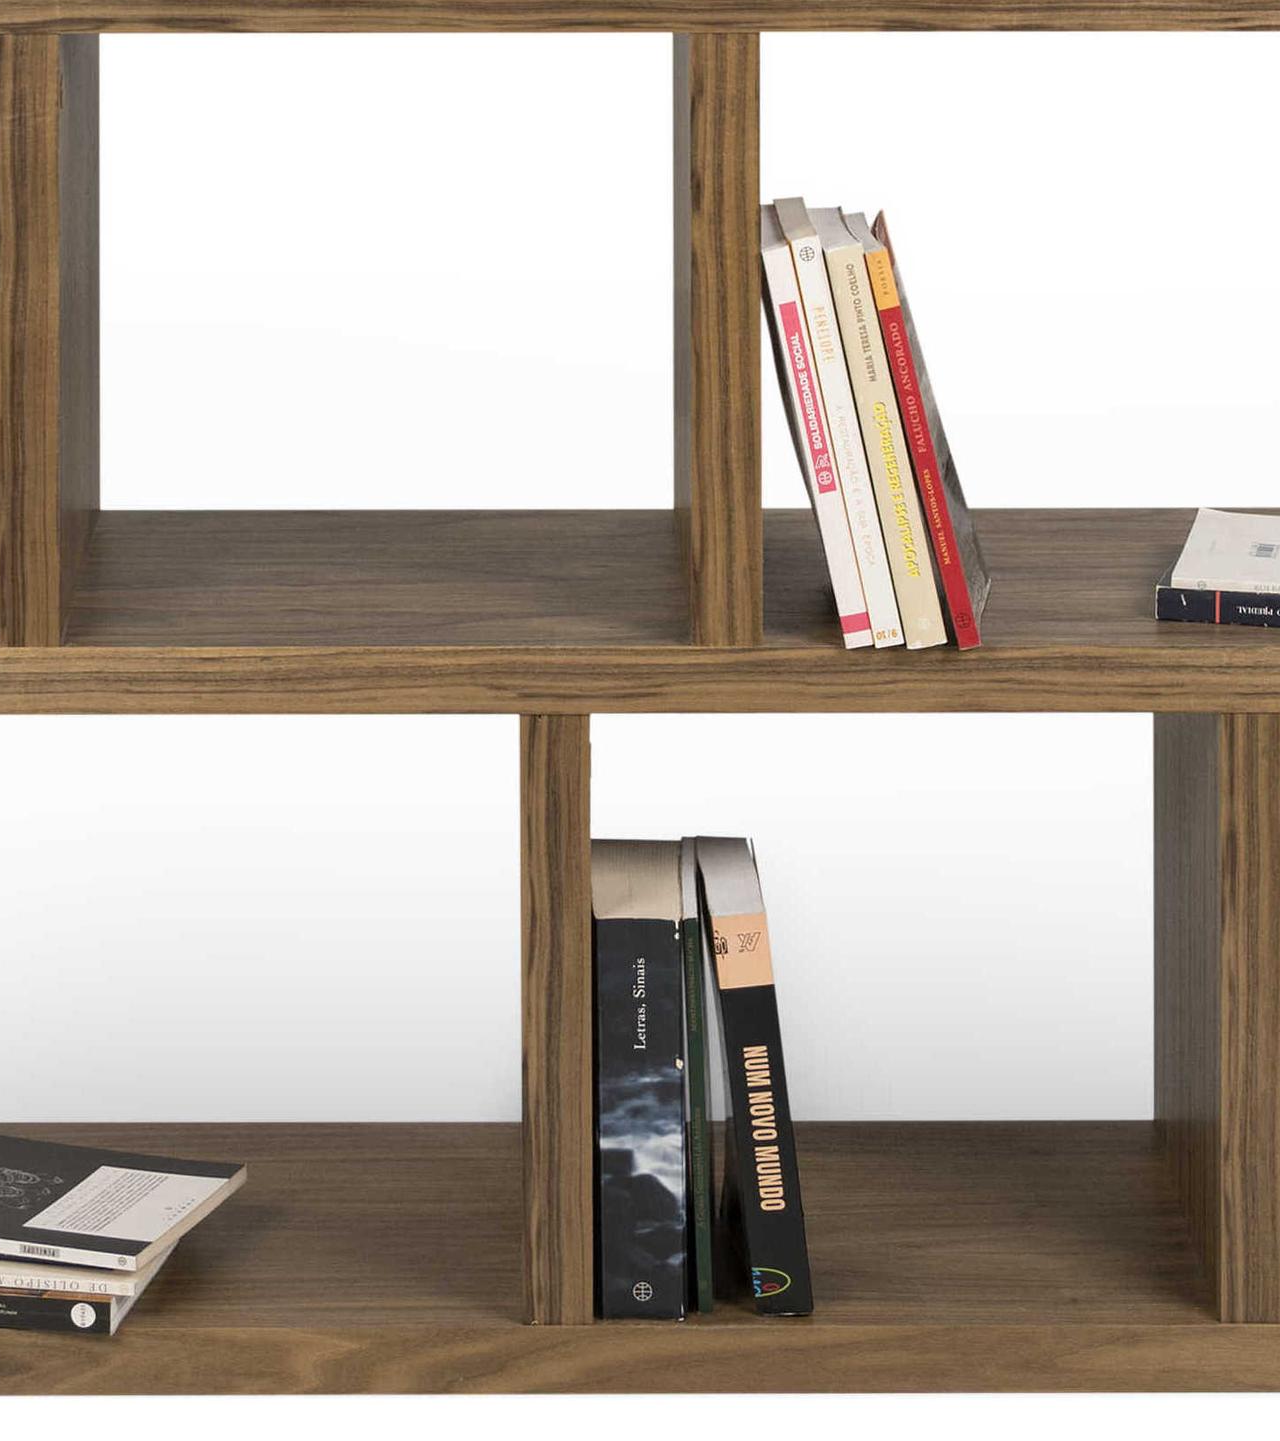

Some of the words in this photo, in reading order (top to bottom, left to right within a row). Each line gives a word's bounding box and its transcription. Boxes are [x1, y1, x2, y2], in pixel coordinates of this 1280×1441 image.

[846, 264, 859, 296] COELHO
[853, 298, 865, 323] PINTO
[791, 332, 805, 369] SOCIAL
[859, 325, 871, 353] TERESA
[890, 323, 912, 390] ANCORADO
[865, 355, 876, 382] MARIA
[799, 372, 822, 449] SOLIDARIEDADE
[906, 396, 926, 452] FALUCHO
[873, 403, 901, 490] REGENERAÇÃO
[892, 493, 904, 501] E
[923, 469, 941, 528] SANTOS-LOPES
[895, 503, 920, 576] APOCALIPSE
[938, 531, 950, 564] MANUEL
[1236, 604, 1273, 616] PREDIAL
[633, 958, 645, 998] Sinais
[634, 1004, 646, 1049] Letras,
[744, 1046, 770, 1086] NUM
[749, 1092, 777, 1140] NOVO
[755, 1146, 784, 1210] MUNDO
[14, 1279, 79, 1292] OLISIPO
[89, 1283, 107, 1292] DE
